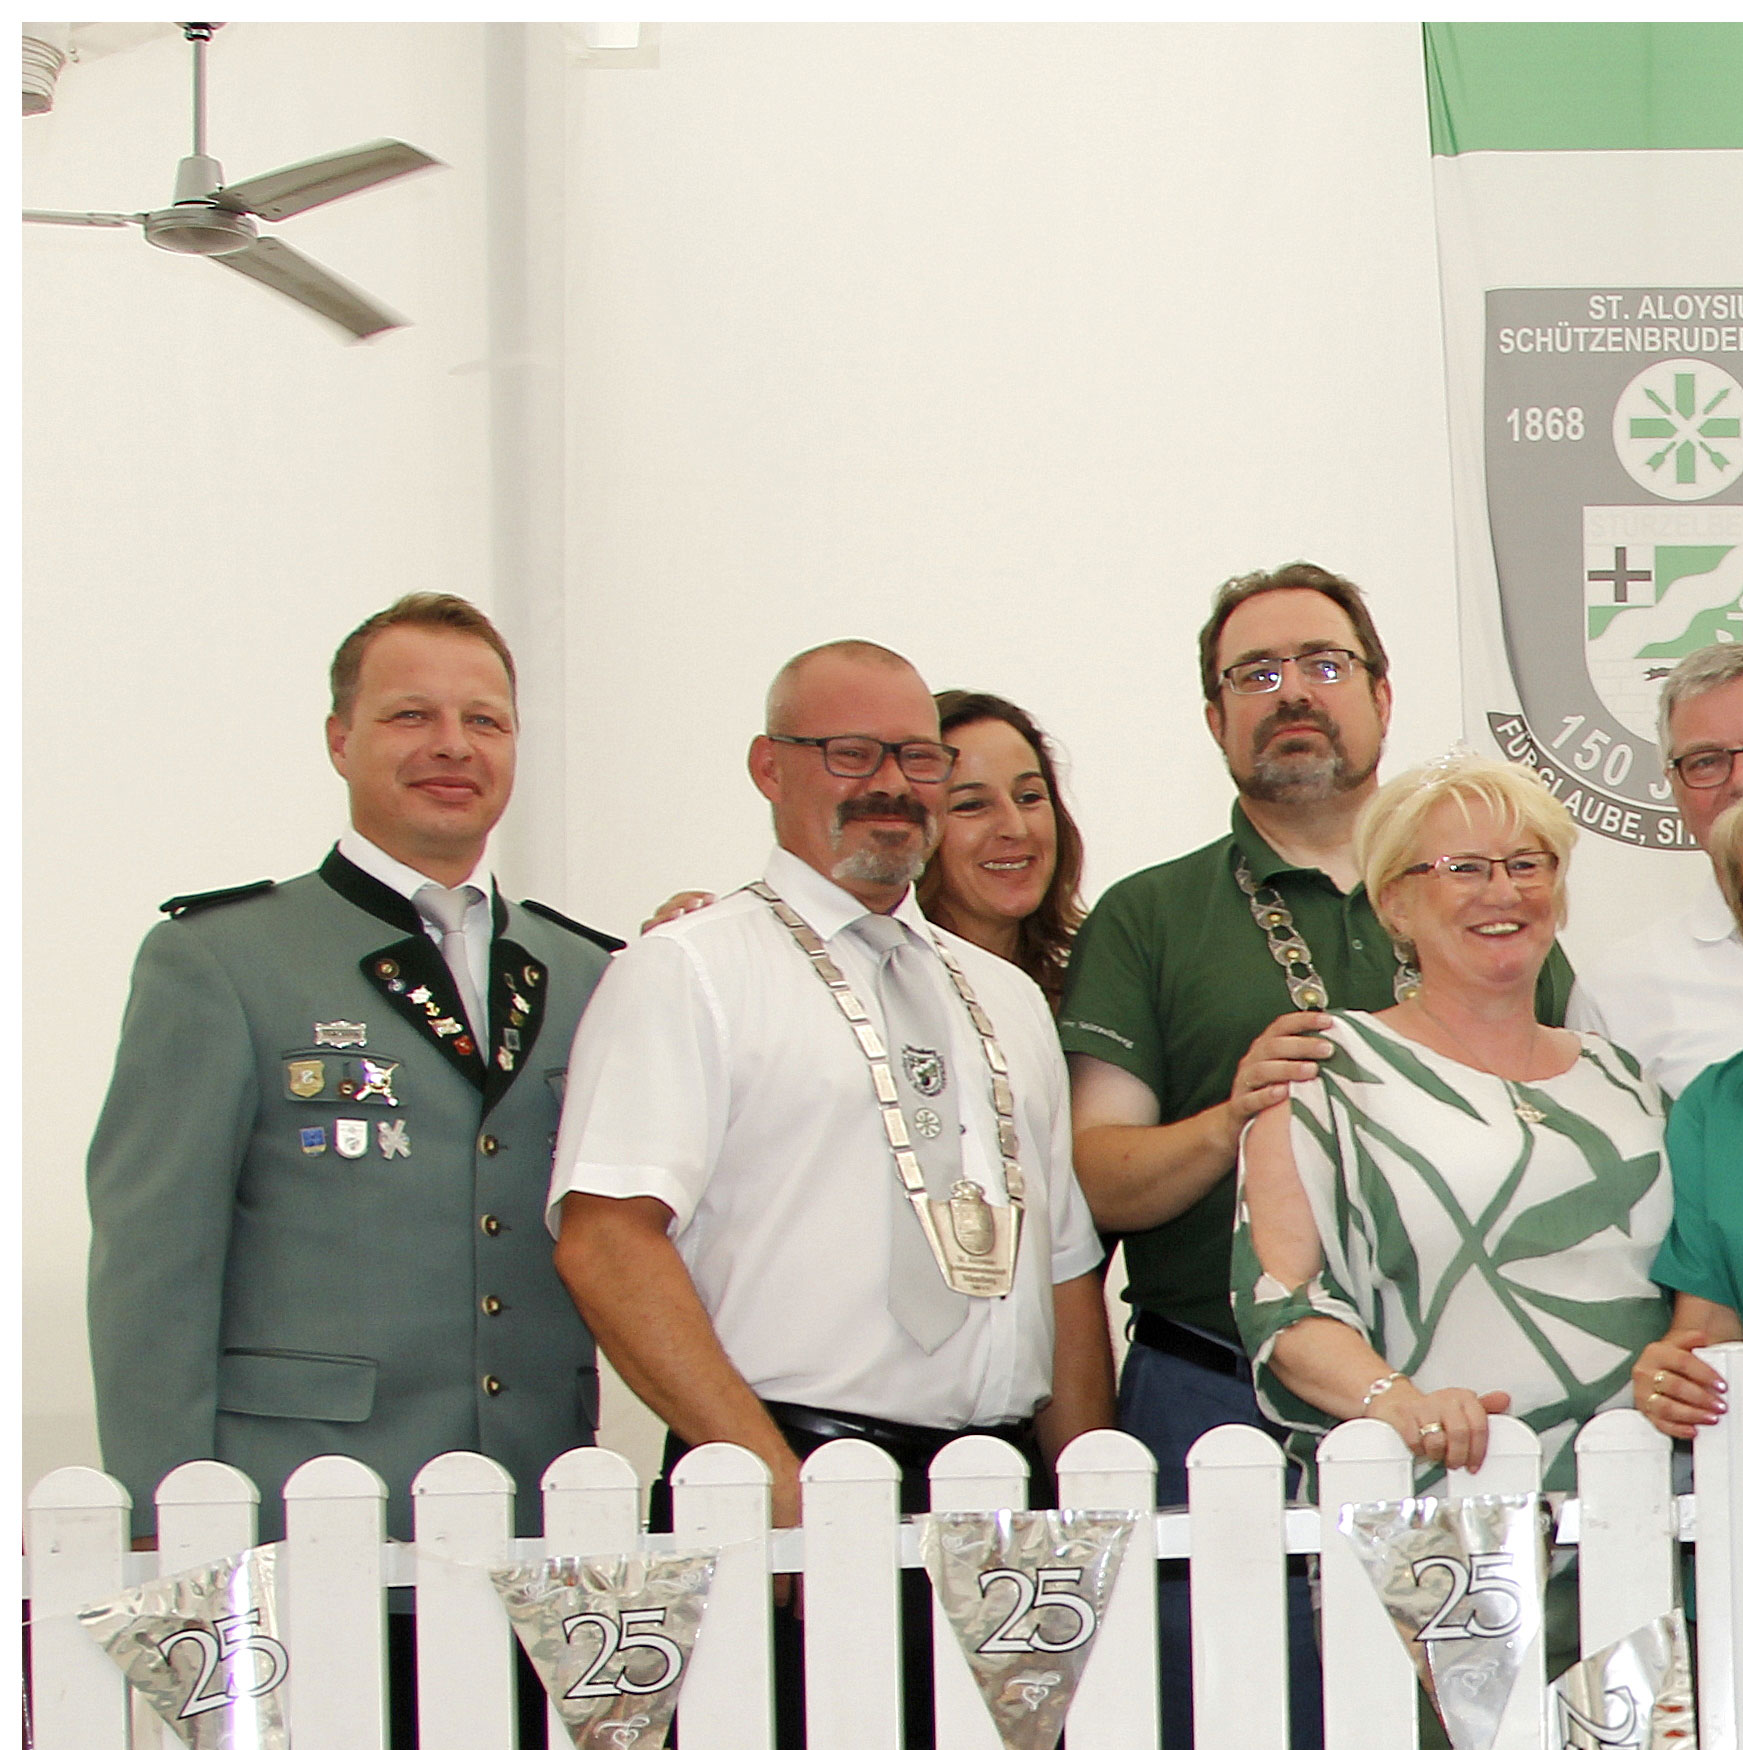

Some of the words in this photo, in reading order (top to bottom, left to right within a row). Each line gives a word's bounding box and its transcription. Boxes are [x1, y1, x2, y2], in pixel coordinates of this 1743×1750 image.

[1588, 295, 1629, 320] ST.
[1506, 407, 1586, 442] 1868
[1496, 719, 1538, 767] FÜR
[1552, 715, 1634, 786] 150
[978, 1567, 1097, 1654] 25
[1412, 1553, 1522, 1642] 25
[157, 1608, 289, 1721] 25
[563, 1607, 684, 1700] 25
